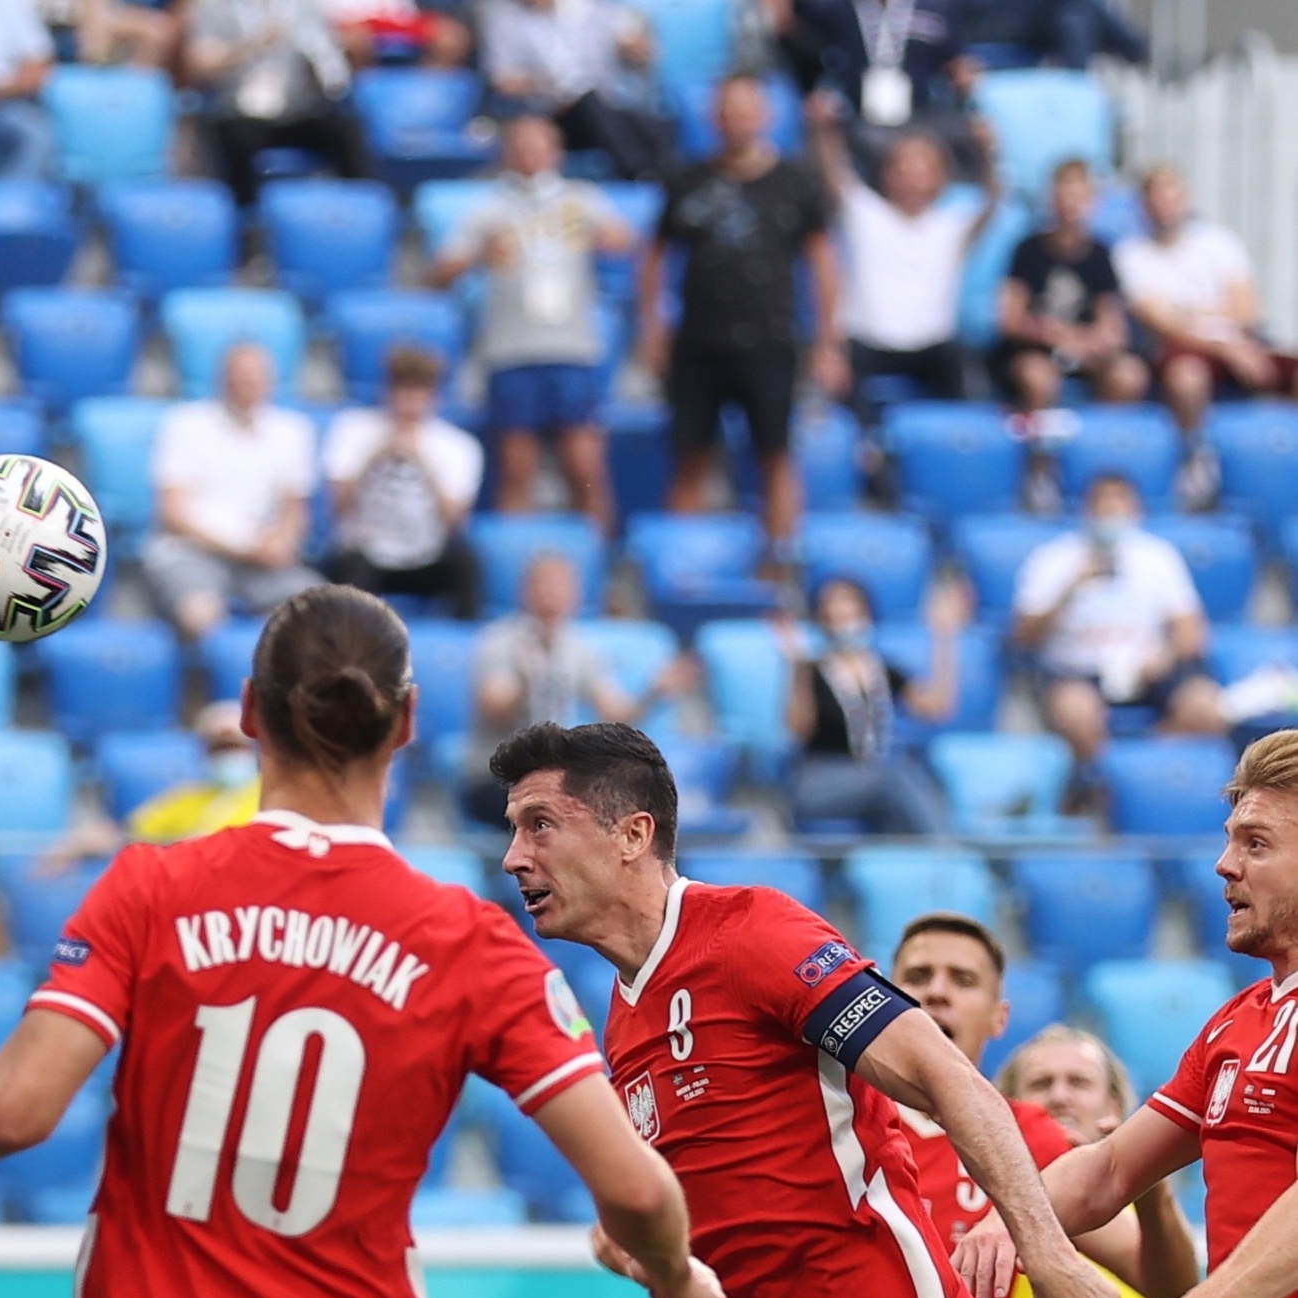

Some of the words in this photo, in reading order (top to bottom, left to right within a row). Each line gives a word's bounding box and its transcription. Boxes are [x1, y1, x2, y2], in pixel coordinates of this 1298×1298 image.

[175, 904, 431, 1012] KRYCHOWIAK
[833, 989, 885, 1038] RESPECT
[165, 995, 367, 1239] 10
